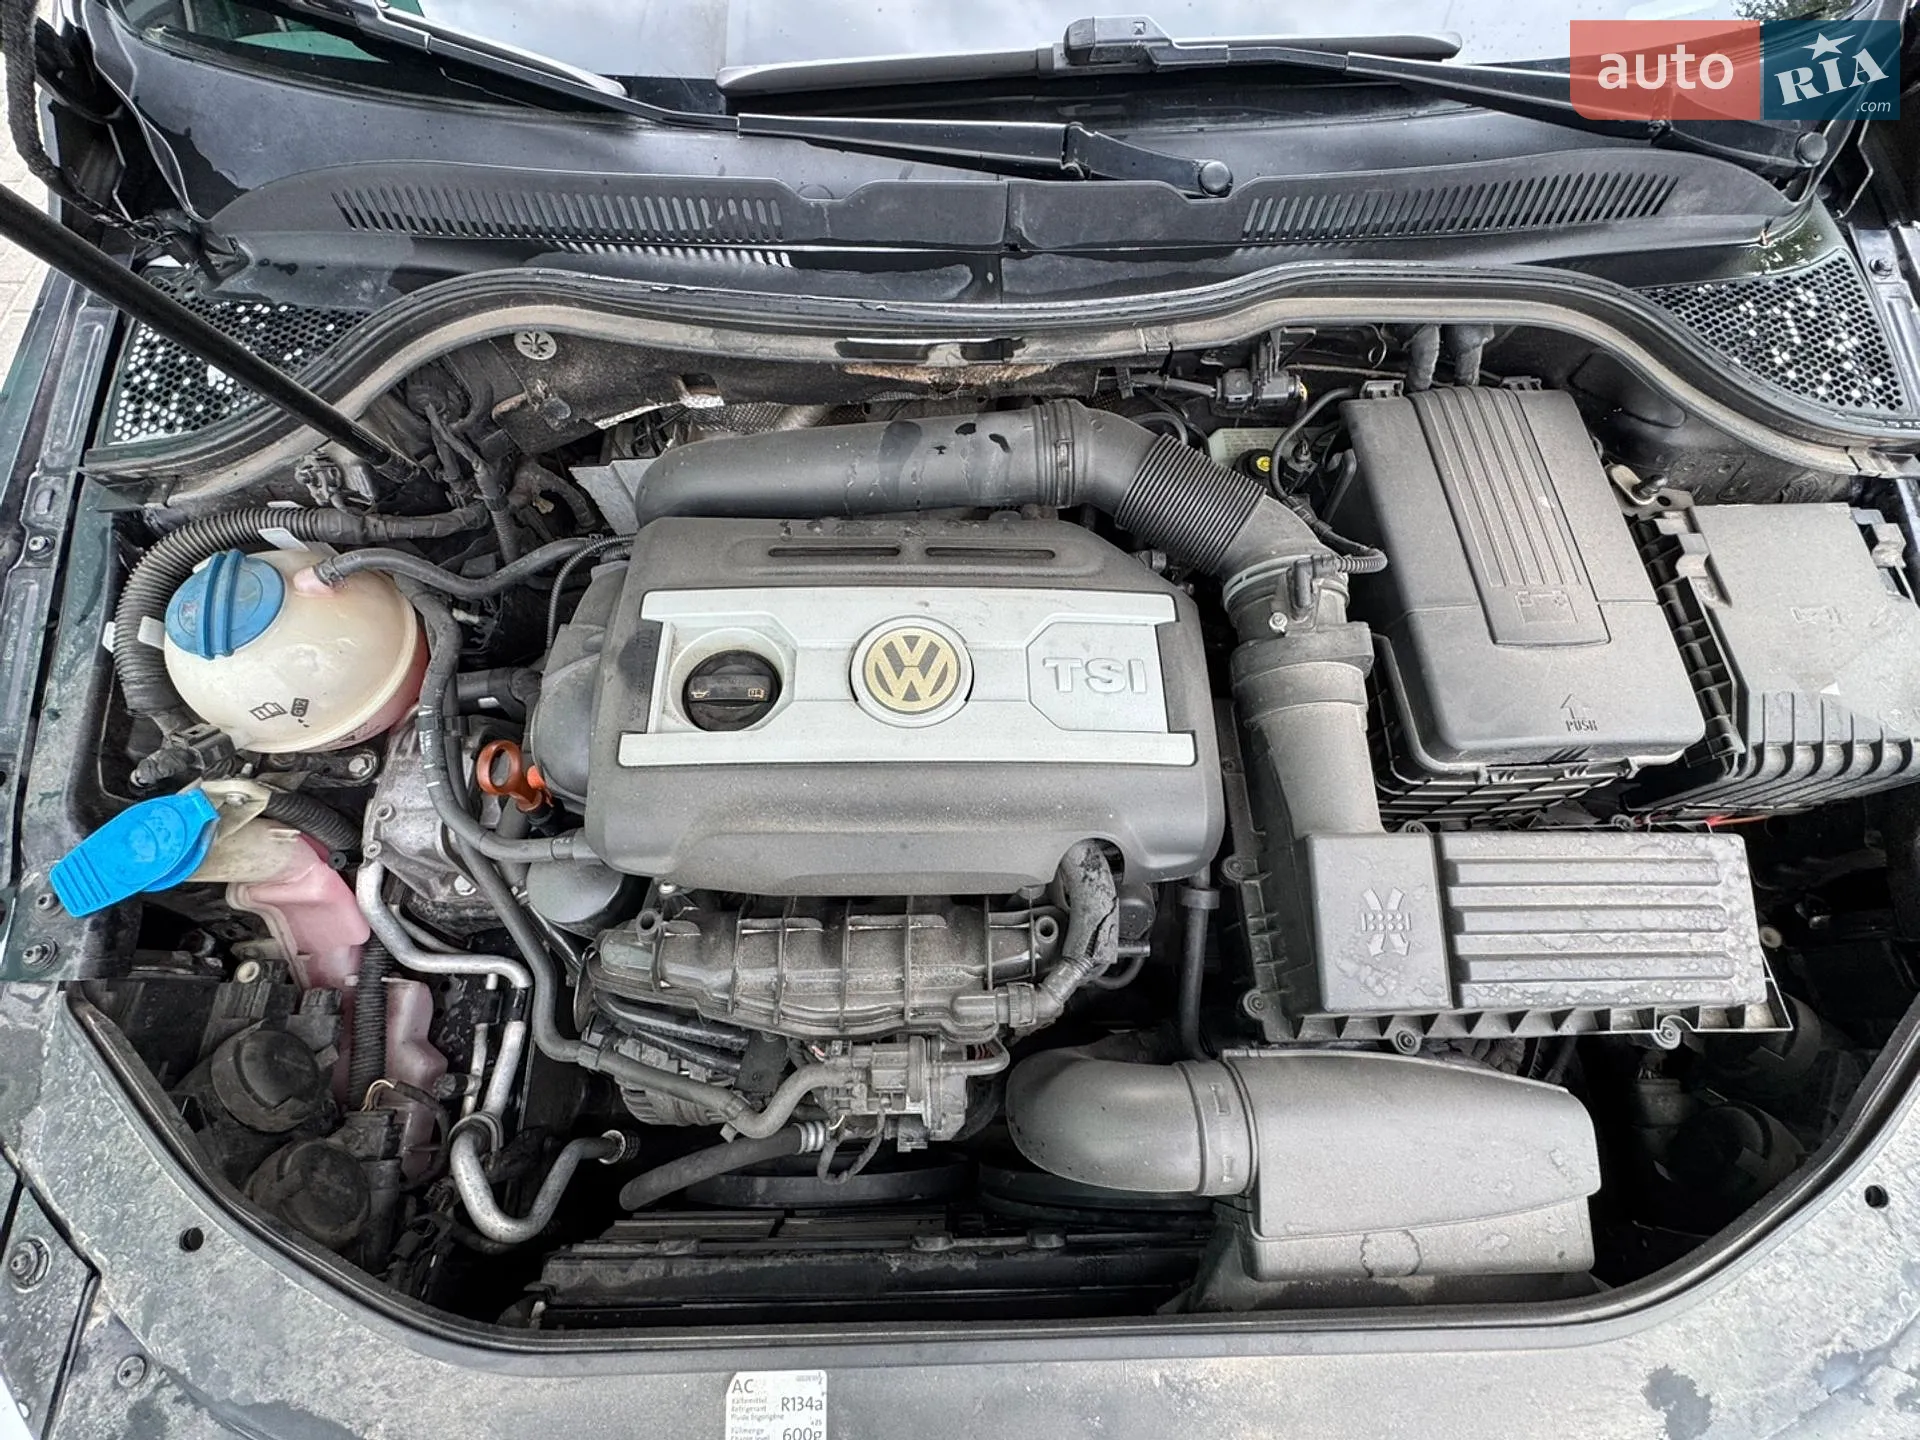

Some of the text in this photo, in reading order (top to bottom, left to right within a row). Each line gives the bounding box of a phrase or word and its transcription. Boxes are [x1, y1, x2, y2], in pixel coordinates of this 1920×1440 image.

[1043, 657, 1149, 694] TSI
[1565, 719, 1598, 732] PUSH
[732, 1379, 754, 1393] AC
[781, 1396, 823, 1412] R134a
